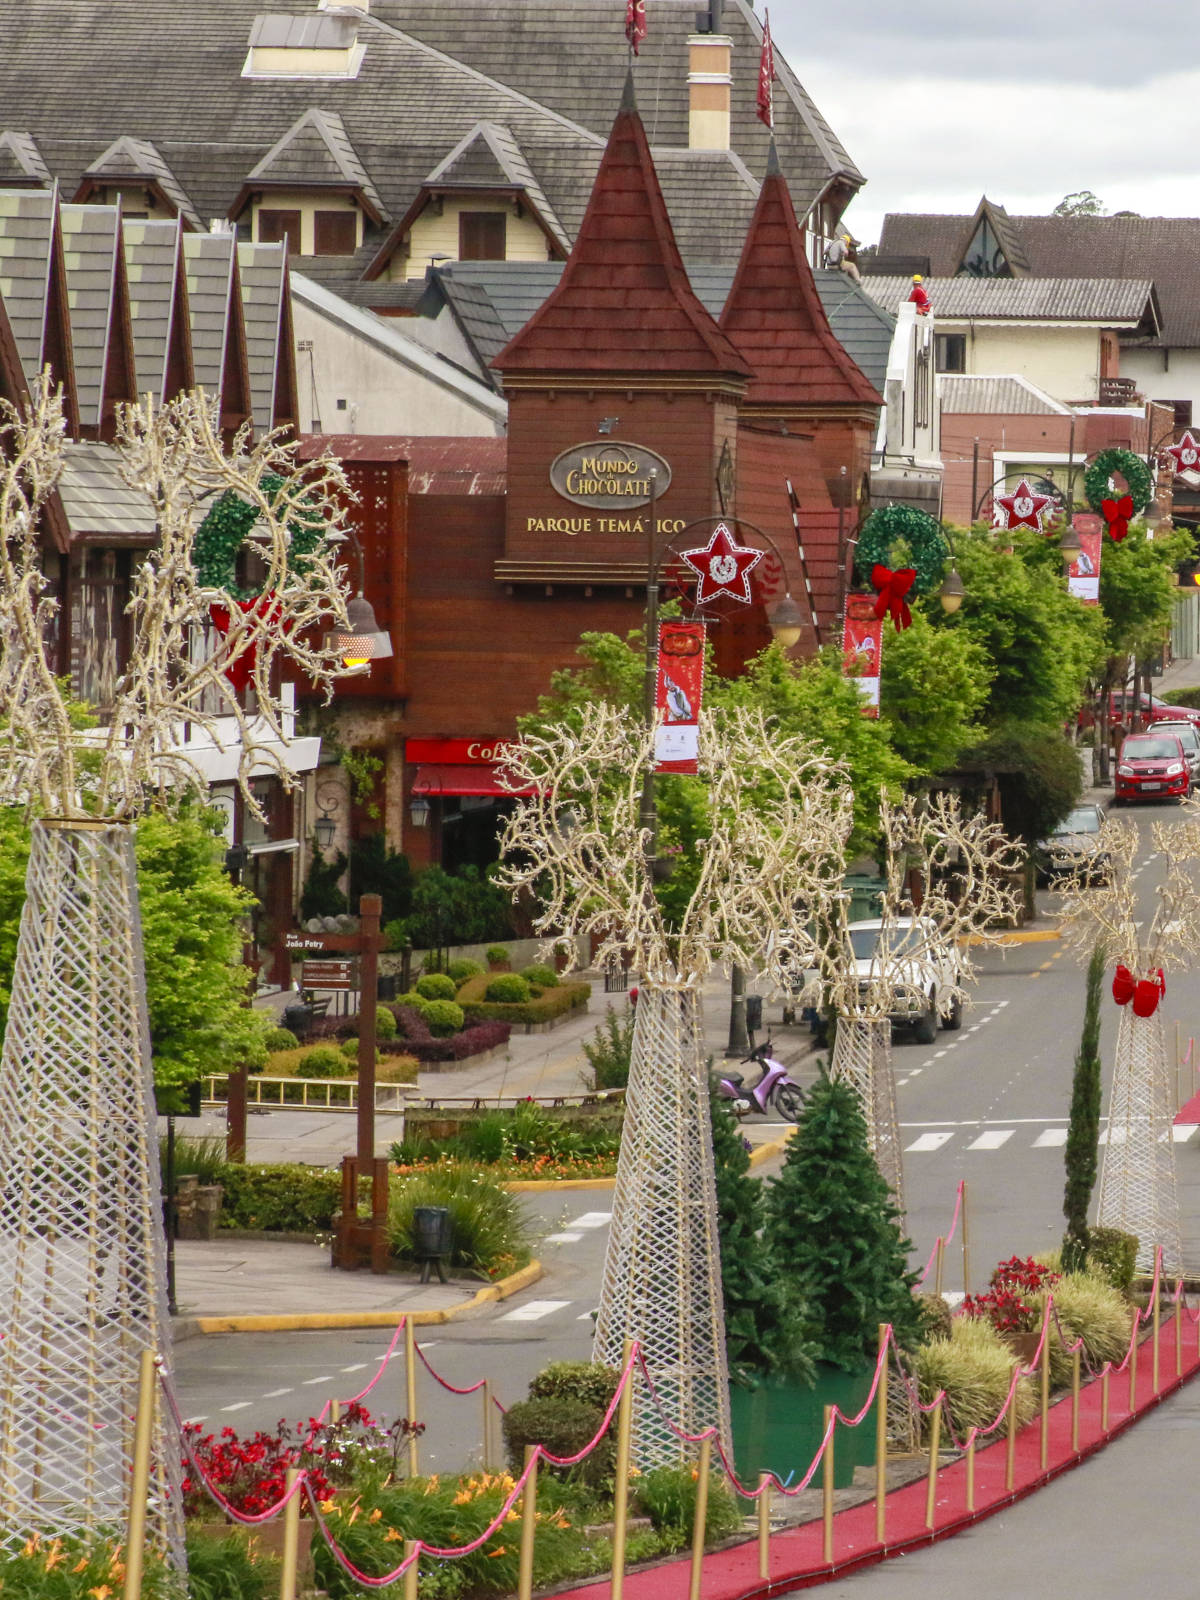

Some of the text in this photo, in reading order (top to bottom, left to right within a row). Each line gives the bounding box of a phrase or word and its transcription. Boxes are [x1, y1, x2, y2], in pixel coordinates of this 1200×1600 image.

[566, 470, 652, 496] CHOCOLATE
[527, 516, 687, 536] PARQUE TEMÁICO
[286, 940, 324, 949] João Petry
